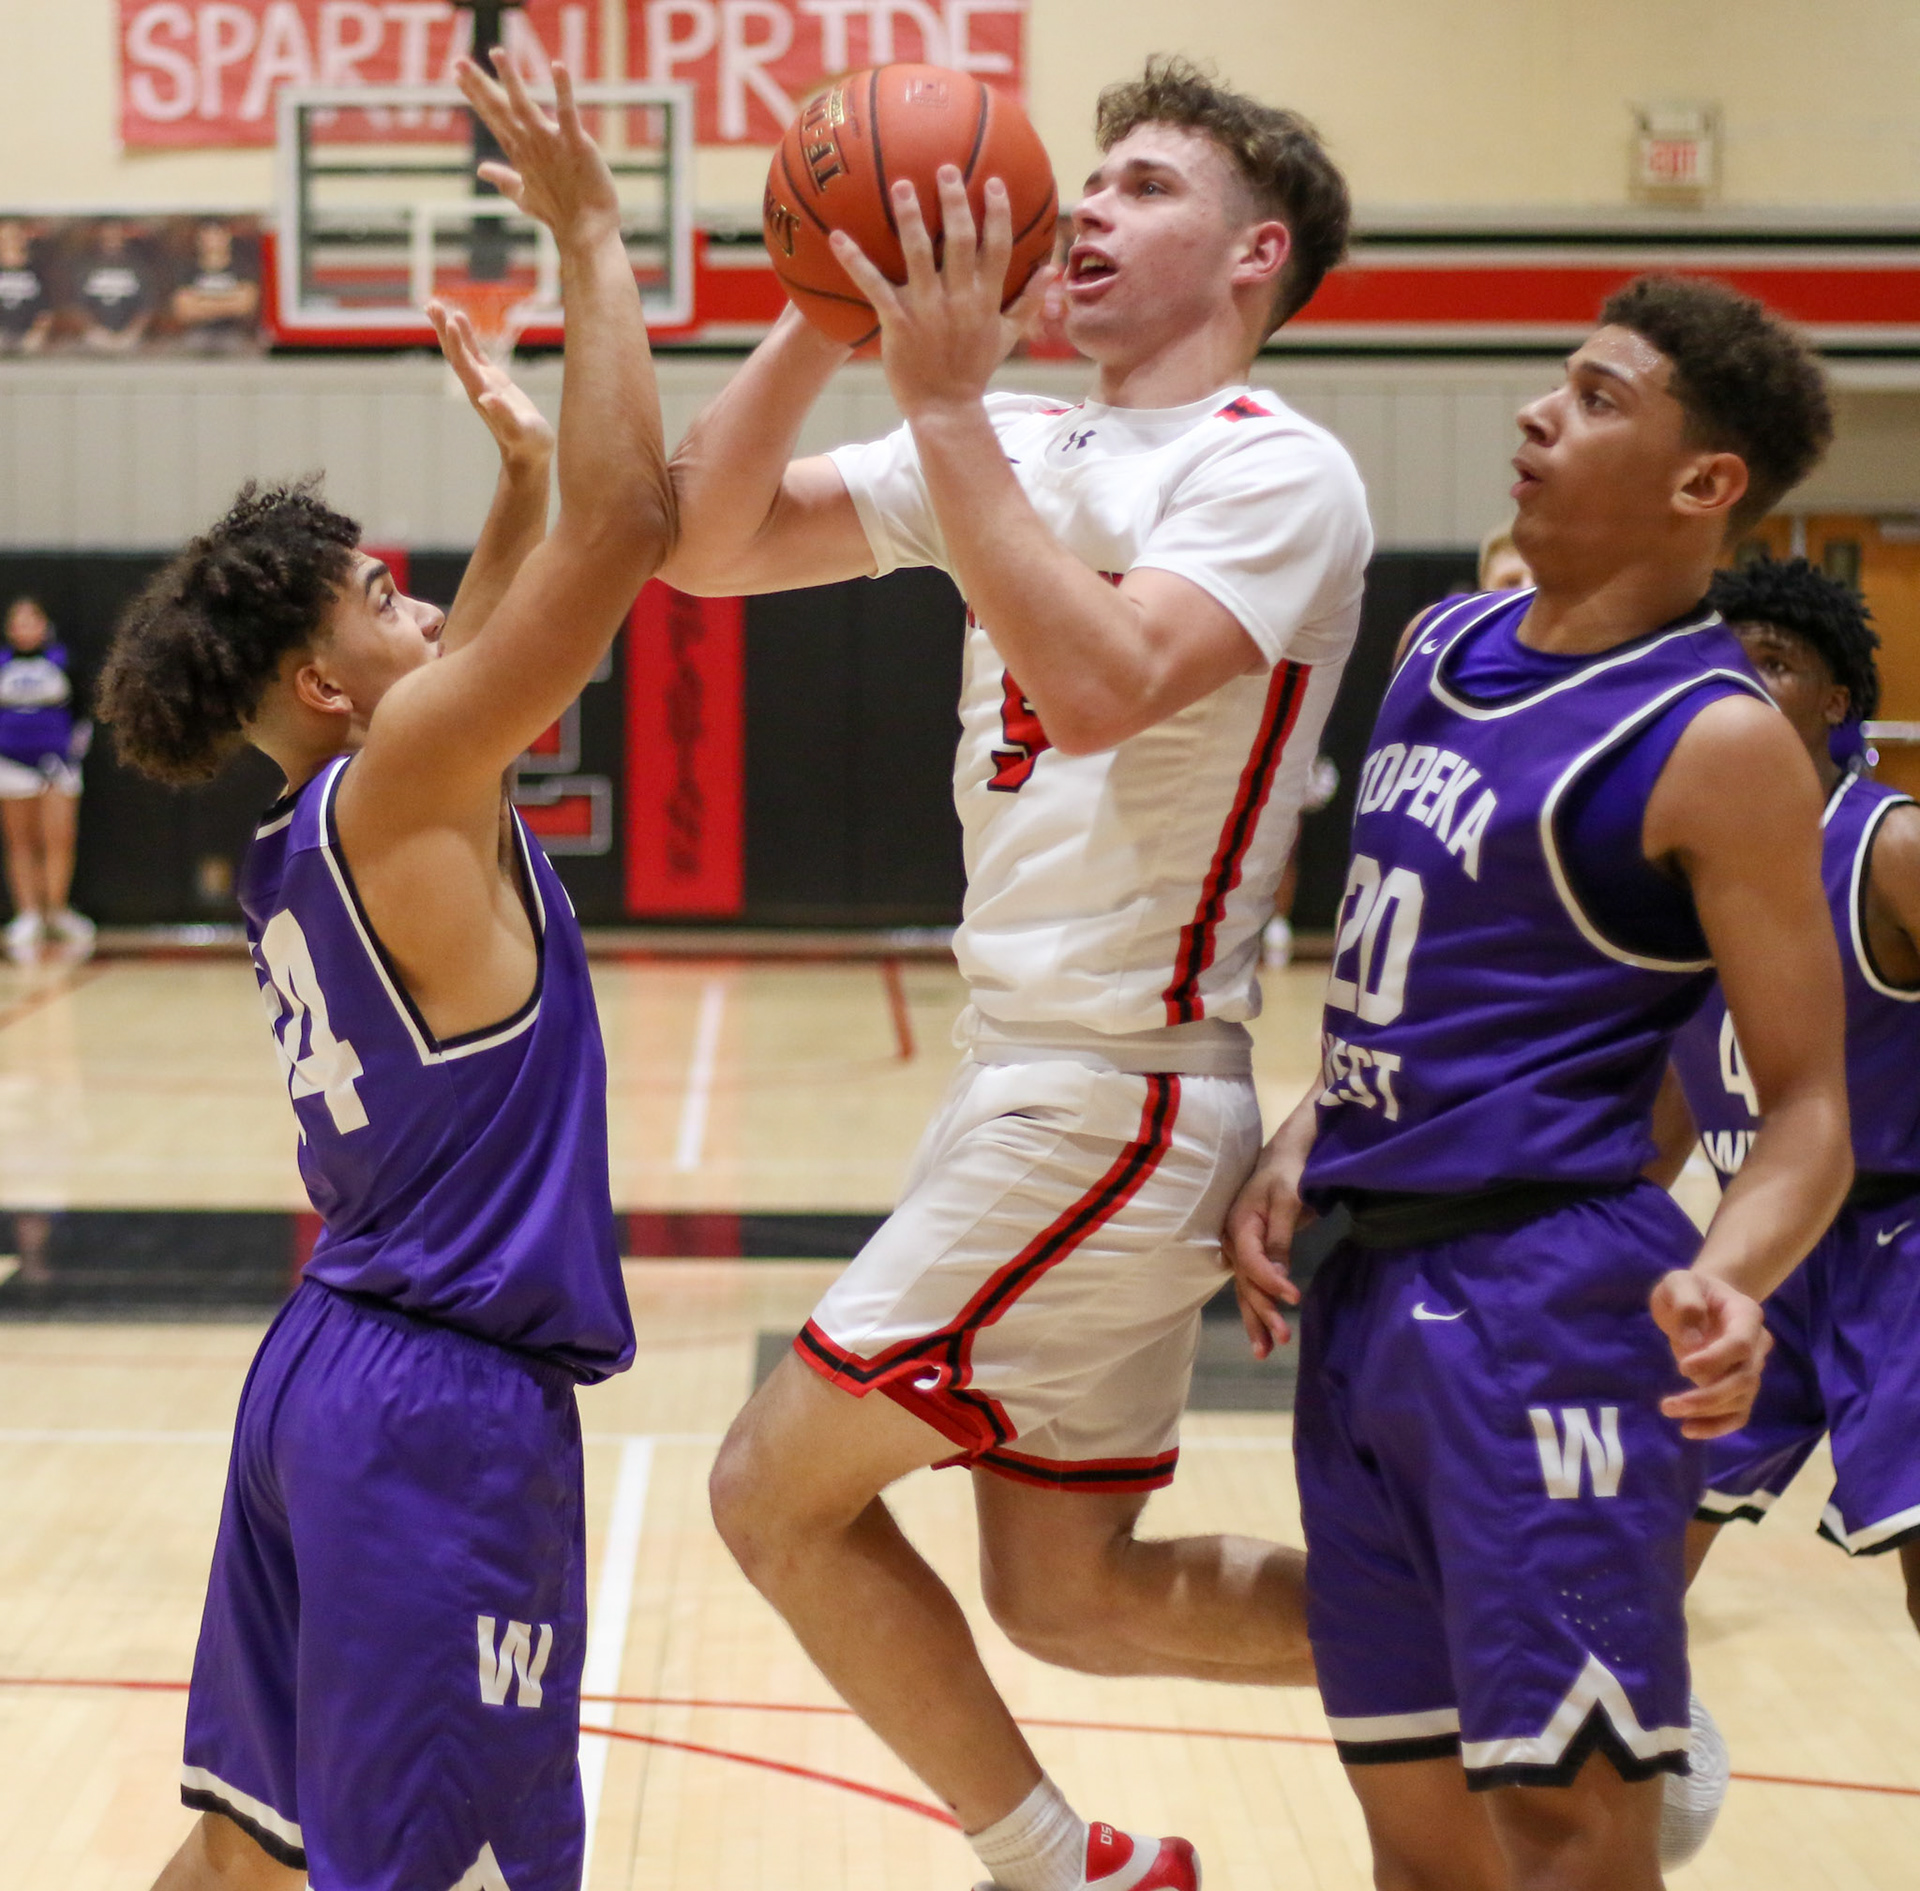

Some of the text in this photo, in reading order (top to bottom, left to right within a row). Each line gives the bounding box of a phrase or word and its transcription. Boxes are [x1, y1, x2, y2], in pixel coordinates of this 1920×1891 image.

[1325, 853, 1425, 1026] 20
[248, 908, 370, 1146] 4
[1319, 1033, 1402, 1122] EST
[1528, 1406, 1624, 1499] W
[477, 1615, 553, 1708] W
